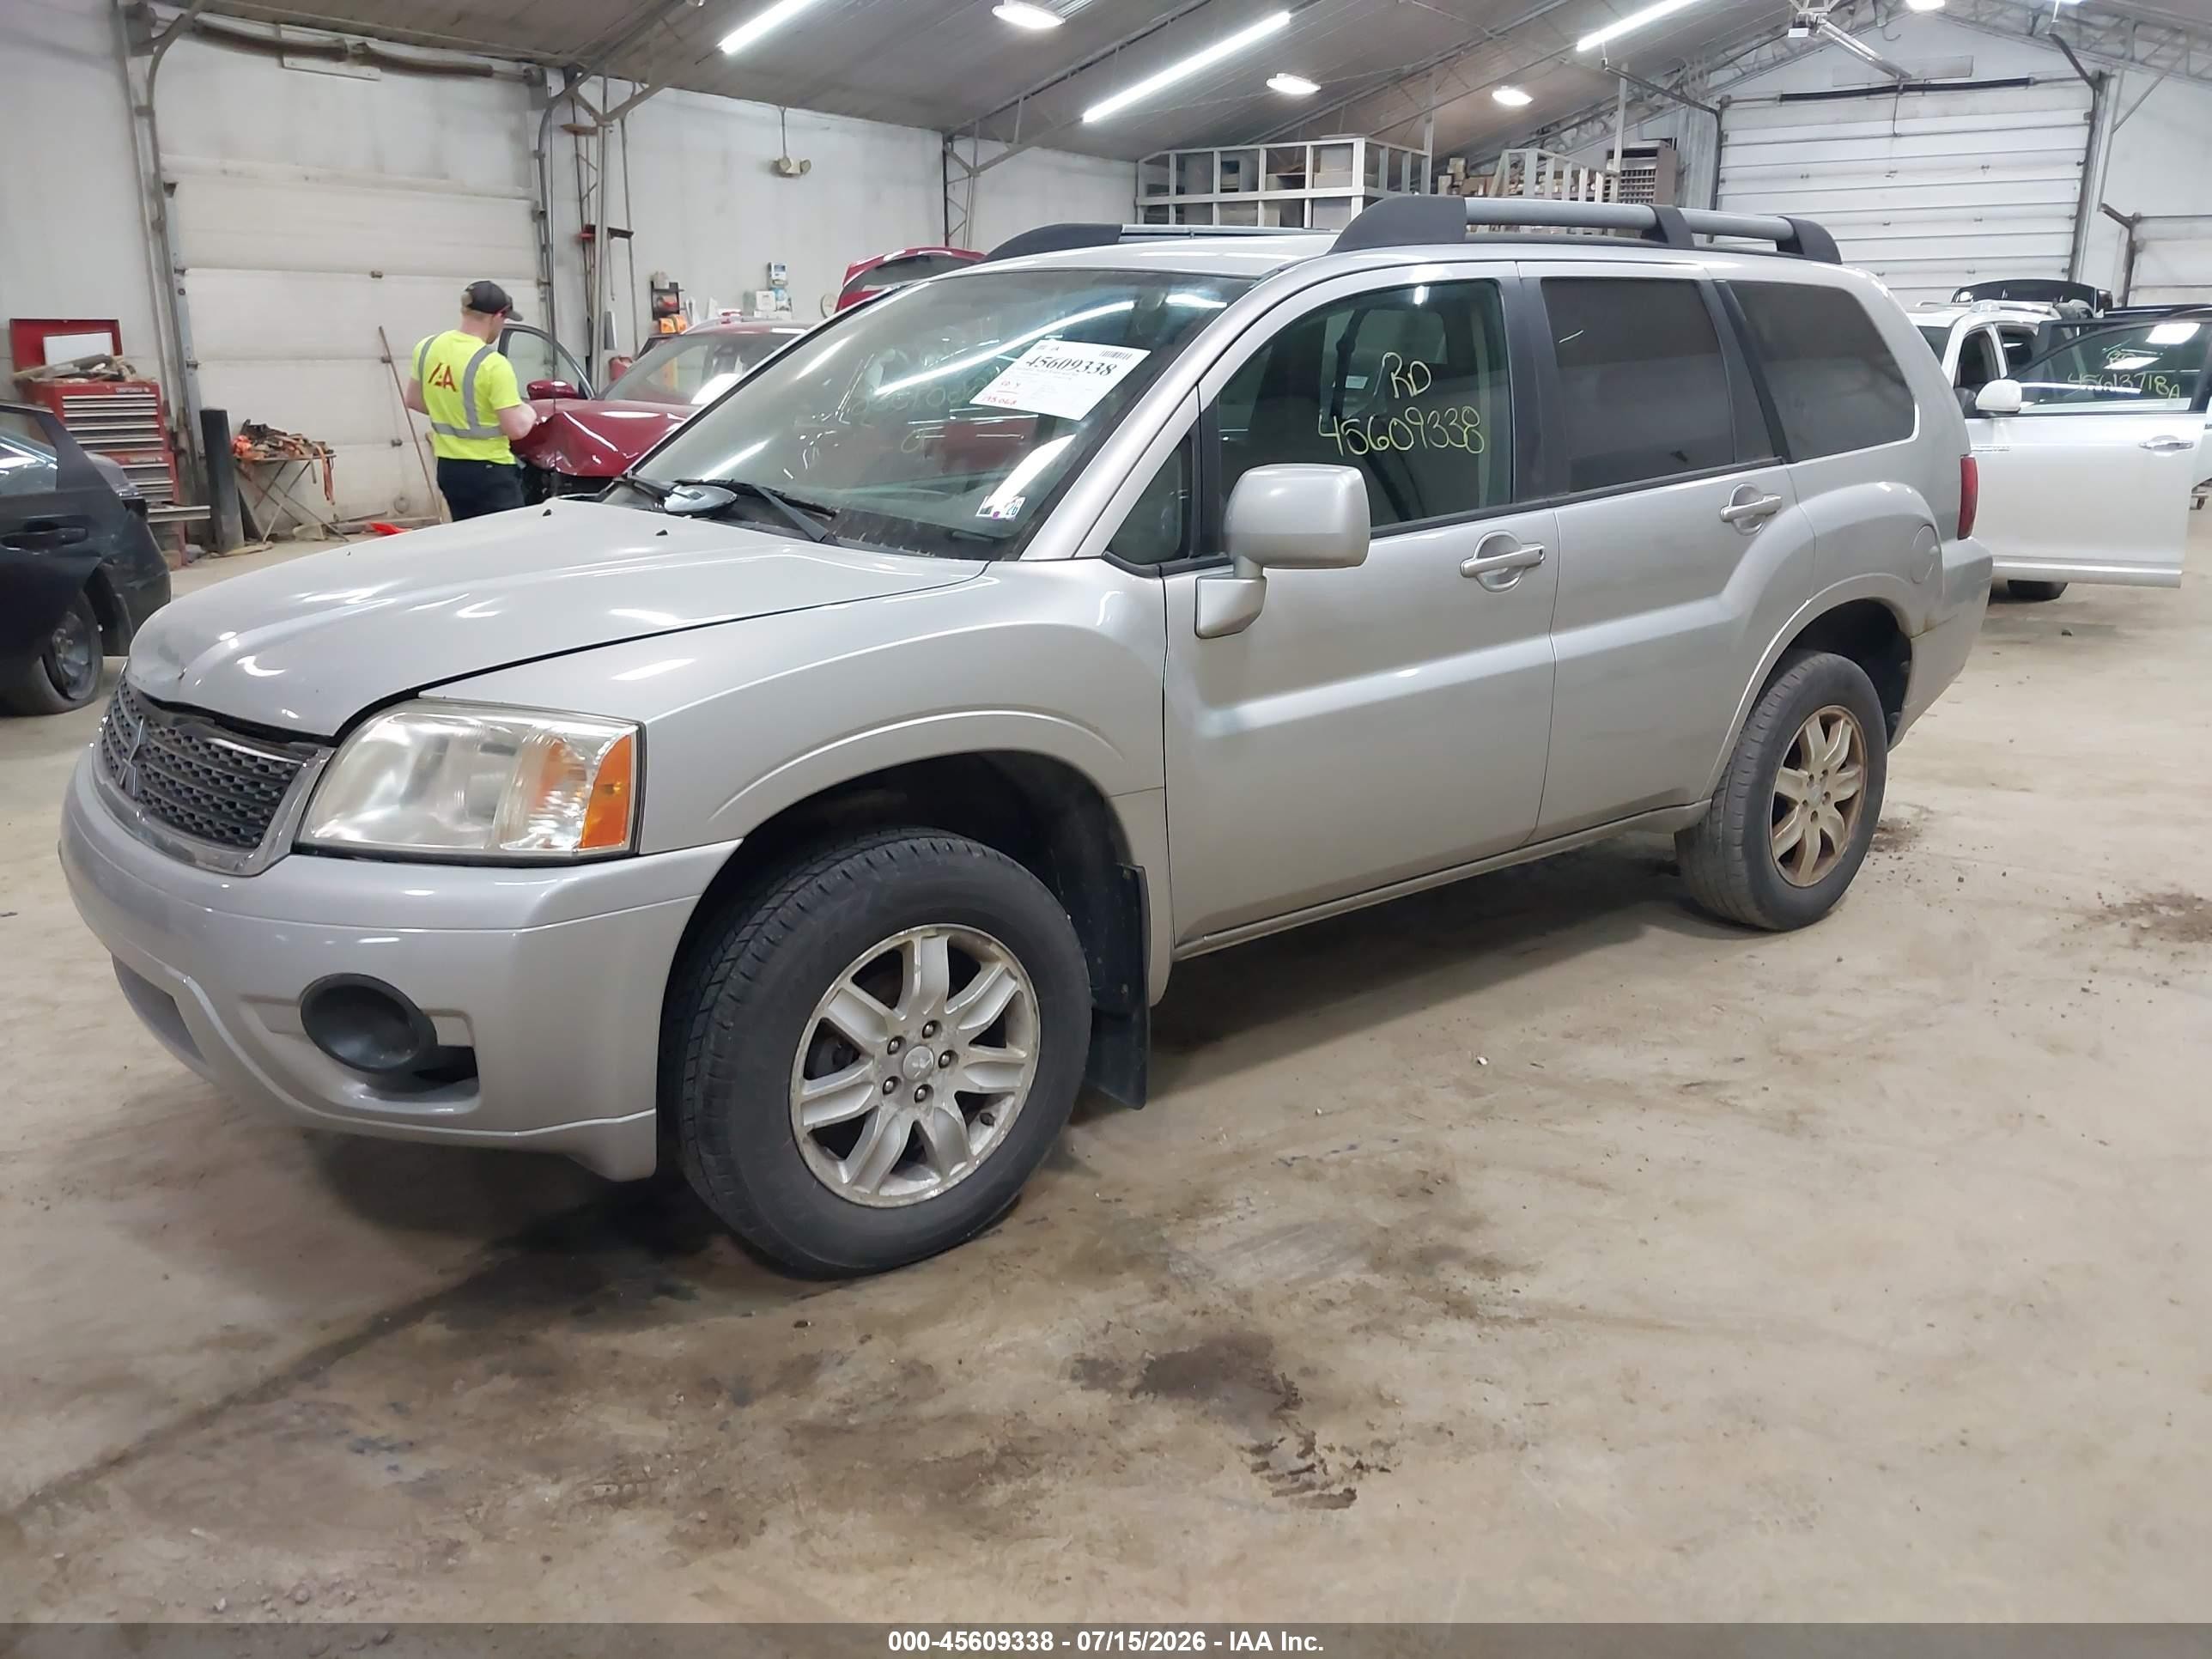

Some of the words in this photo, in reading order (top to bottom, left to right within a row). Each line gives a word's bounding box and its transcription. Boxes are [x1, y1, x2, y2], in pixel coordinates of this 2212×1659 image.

[1025, 355, 1117, 376] 45609338
[1374, 352, 1432, 399] RD
[1318, 405, 1485, 457] 45609338
